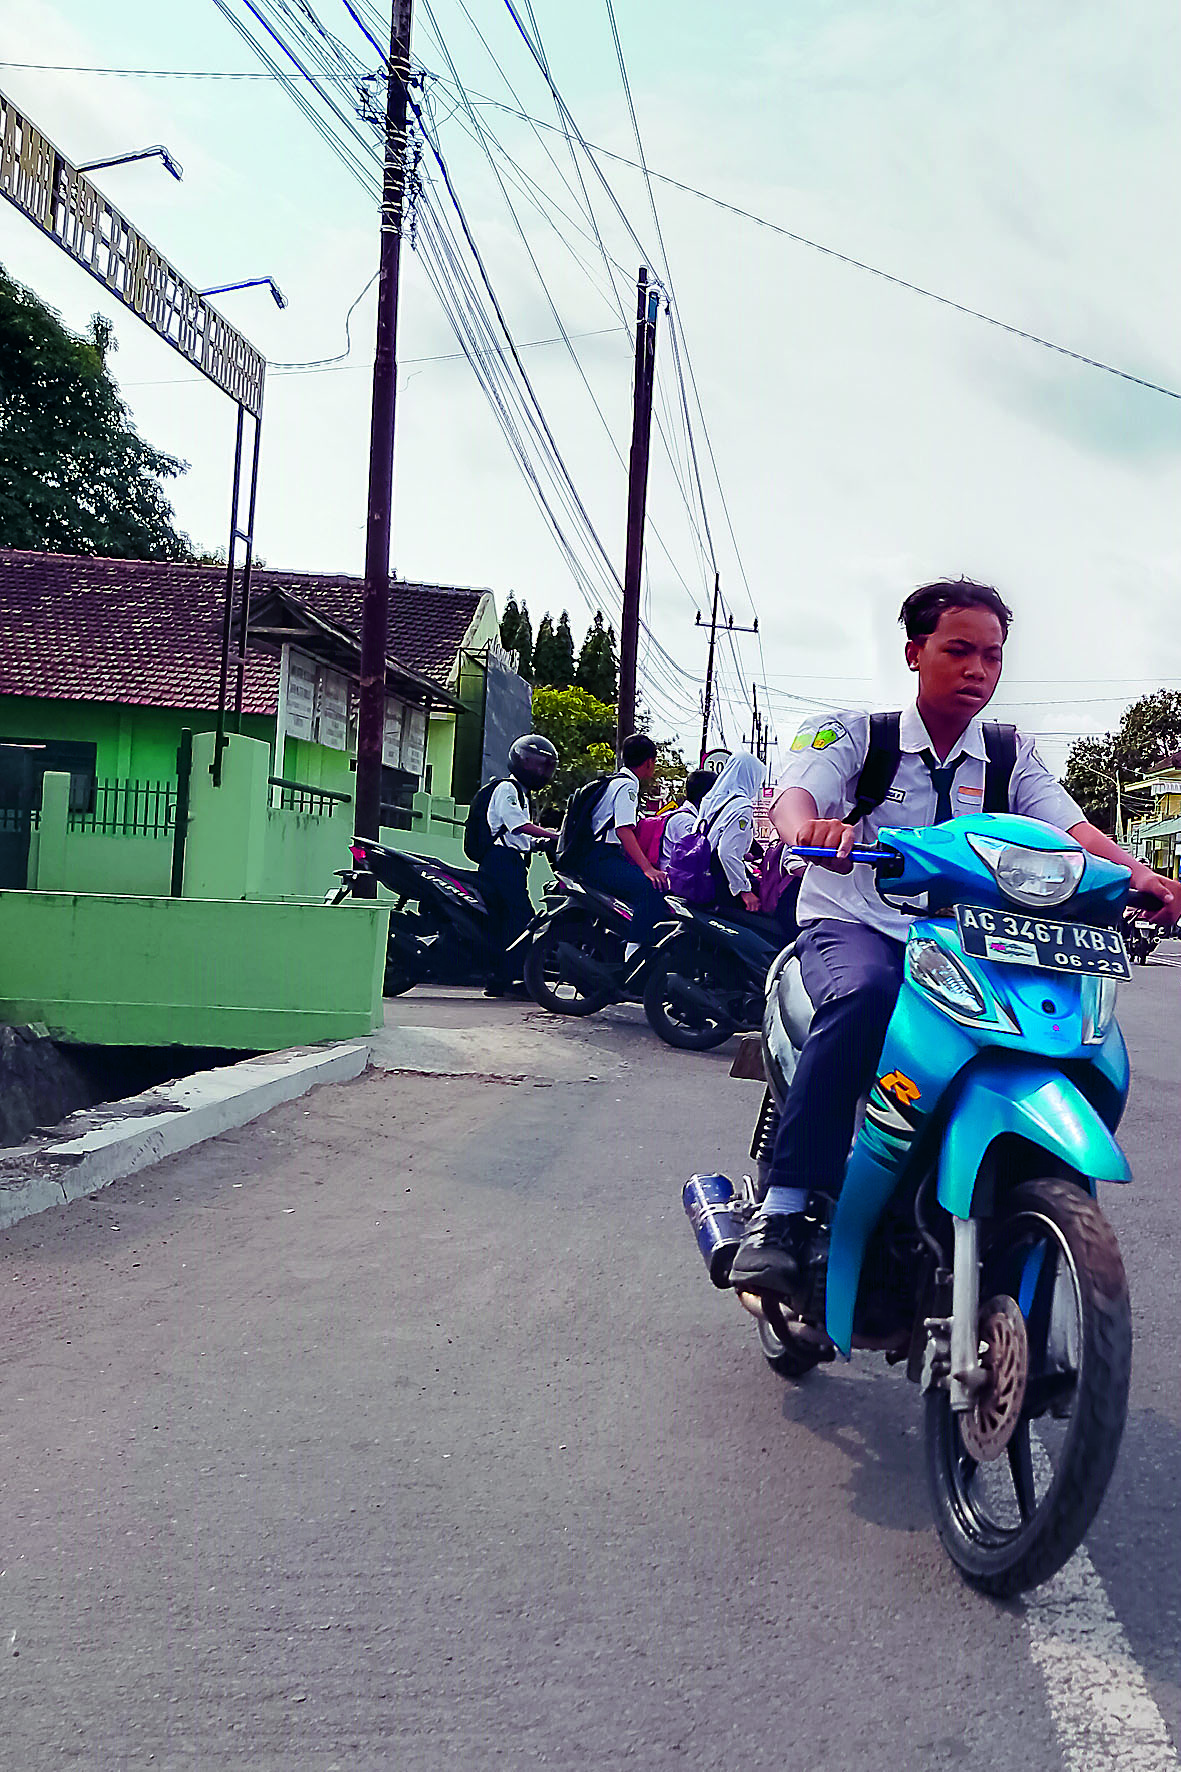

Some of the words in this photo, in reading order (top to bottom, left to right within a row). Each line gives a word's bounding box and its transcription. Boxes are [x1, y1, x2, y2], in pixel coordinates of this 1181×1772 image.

[963, 909, 995, 933] AG
[1002, 916, 1064, 945] 3467
[1072, 928, 1122, 954] KBJ
[880, 1069, 921, 1106] R
